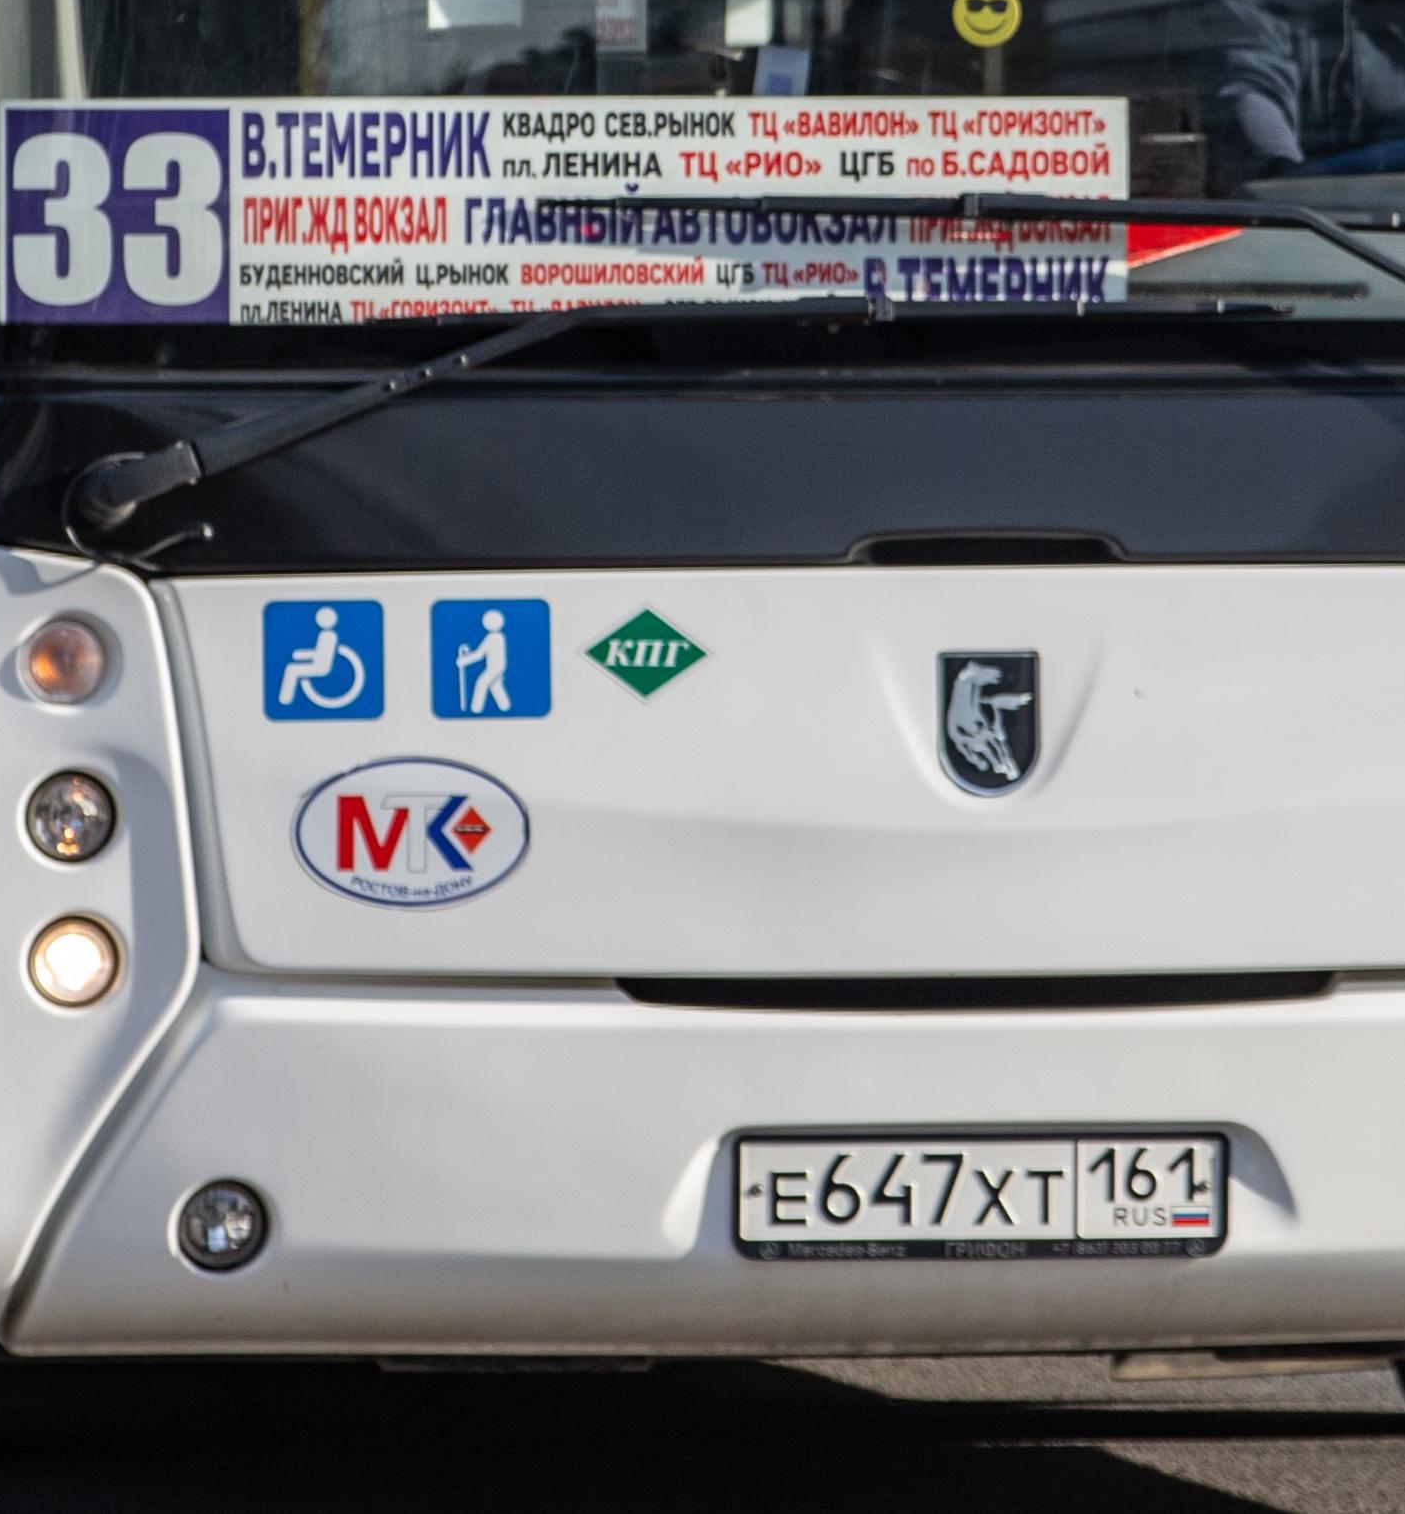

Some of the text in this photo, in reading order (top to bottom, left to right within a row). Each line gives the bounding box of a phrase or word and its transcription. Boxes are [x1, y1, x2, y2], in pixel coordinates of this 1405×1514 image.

[242, 111, 491, 178] В.ТЕМЕРНИК
[503, 110, 1106, 142] КВАДРО СЕВ.РЫНОК ТЦ «ВАВИЛОН» ТЦ «ГОРИЗОНТ»
[680, 152, 718, 183] ТЦ
[725, 152, 822, 178] «РИО»
[840, 152, 895, 182] ЦГБ
[906, 157, 935, 176] по
[941, 142, 1110, 181] Б.САДОВОЙ
[12, 132, 224, 306] 33
[244, 196, 349, 253] ПРИГ.ЖД
[354, 196, 447, 243] ВОКЗАЛ
[240, 255, 858, 289] БУДЕННОВСКИЙ Ц.РЫНОК ВОРОШИЛОВСКИЙ ЦГБ ТЦ «РИО»
[603, 637, 694, 669] КПГ
[769, 1146, 1202, 1227] Е647ХТ 161
[1113, 1206, 1167, 1227] RUS
